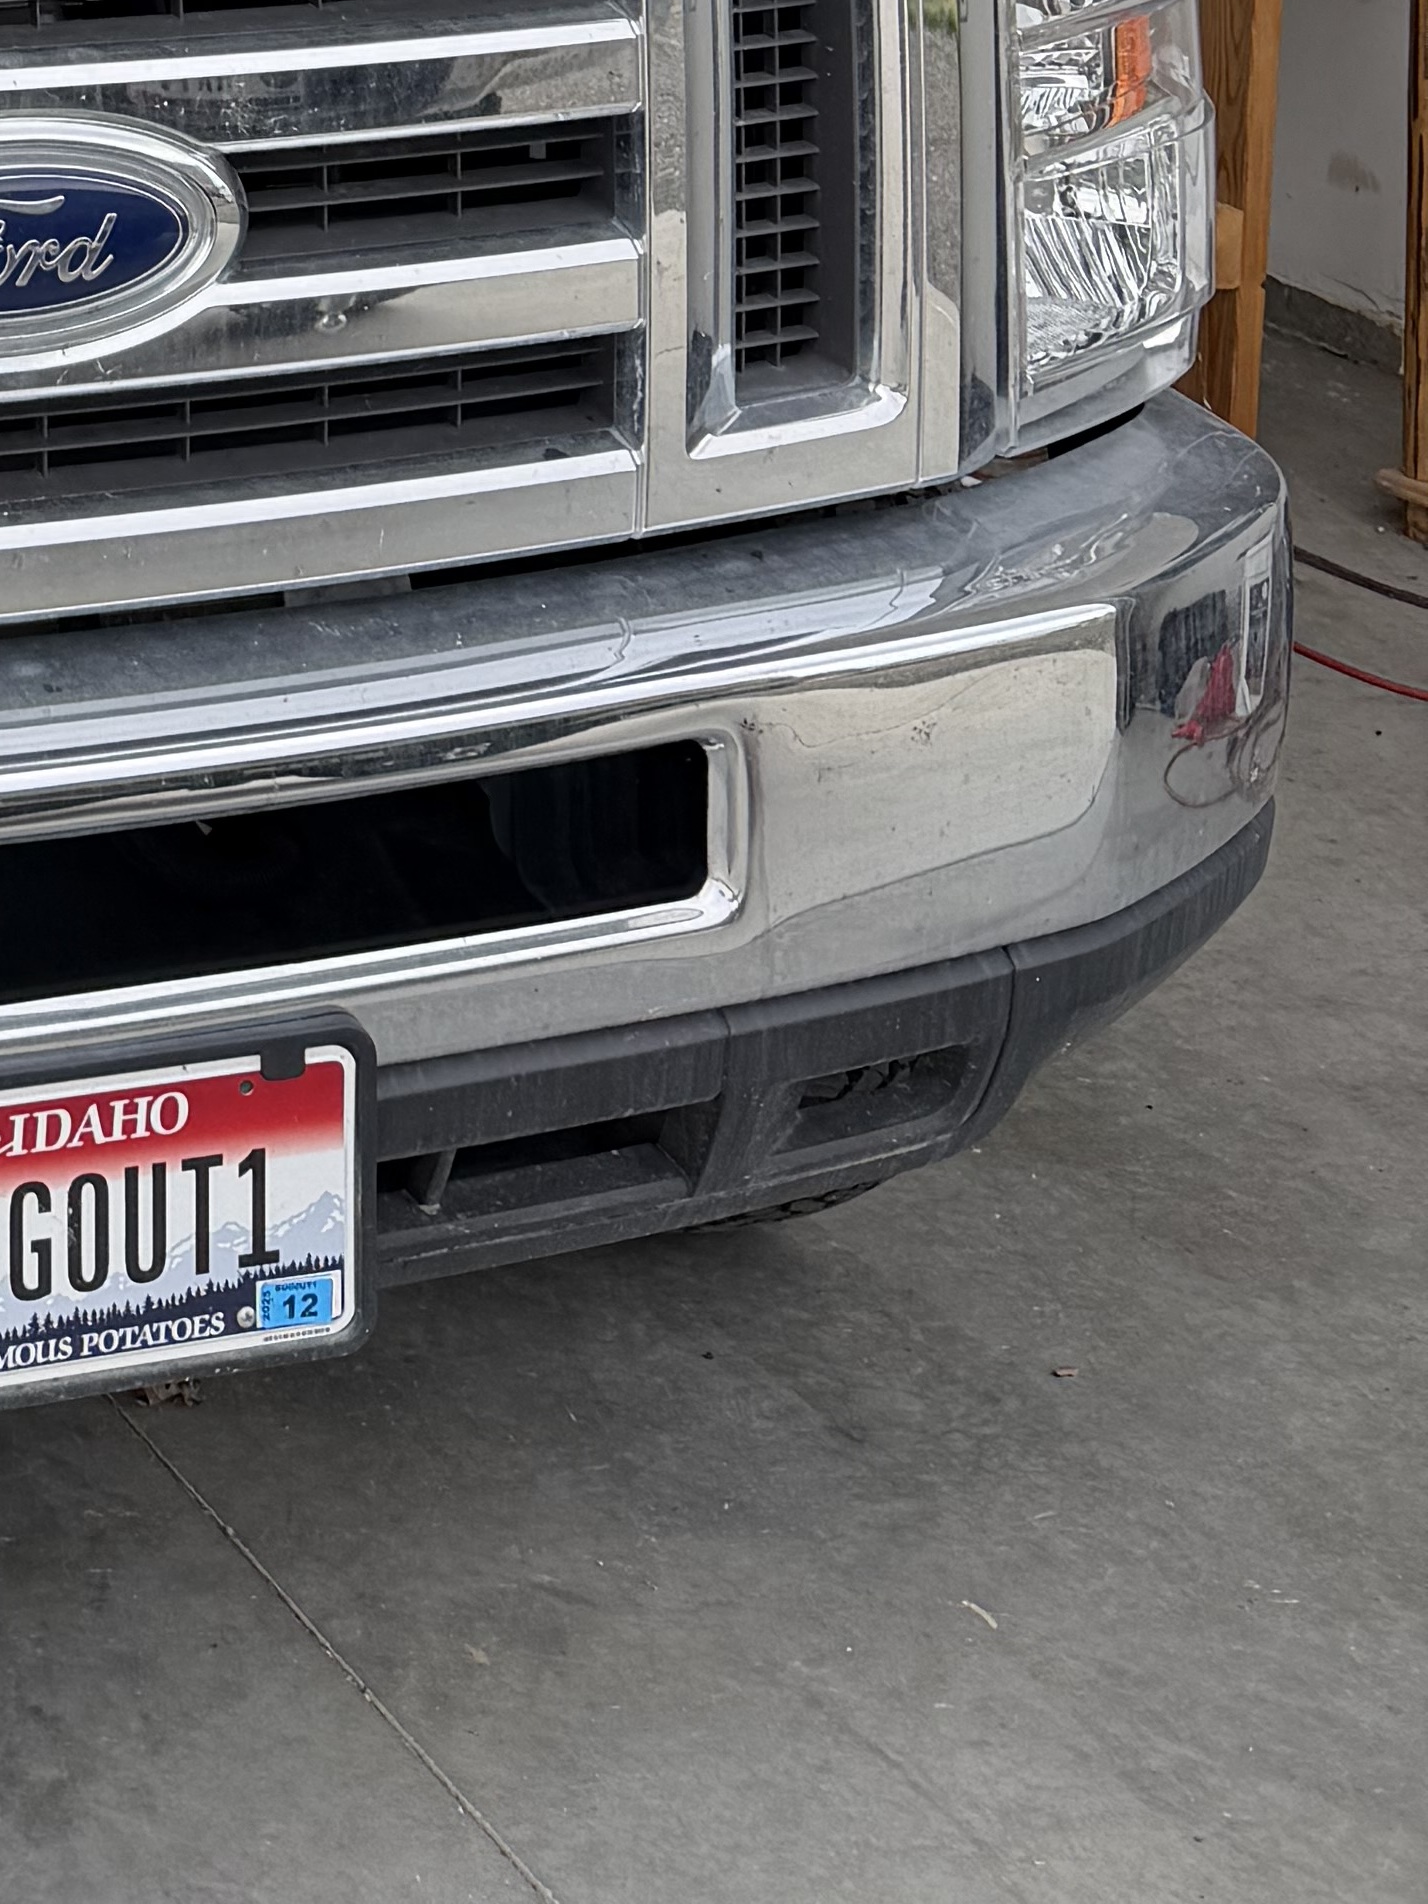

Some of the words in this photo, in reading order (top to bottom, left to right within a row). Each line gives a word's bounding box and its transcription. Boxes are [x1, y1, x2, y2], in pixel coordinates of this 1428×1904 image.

[6, 1091, 190, 1158] IDAHO
[282, 1292, 319, 1320] 12
[80, 1311, 226, 1359] POTATOES
